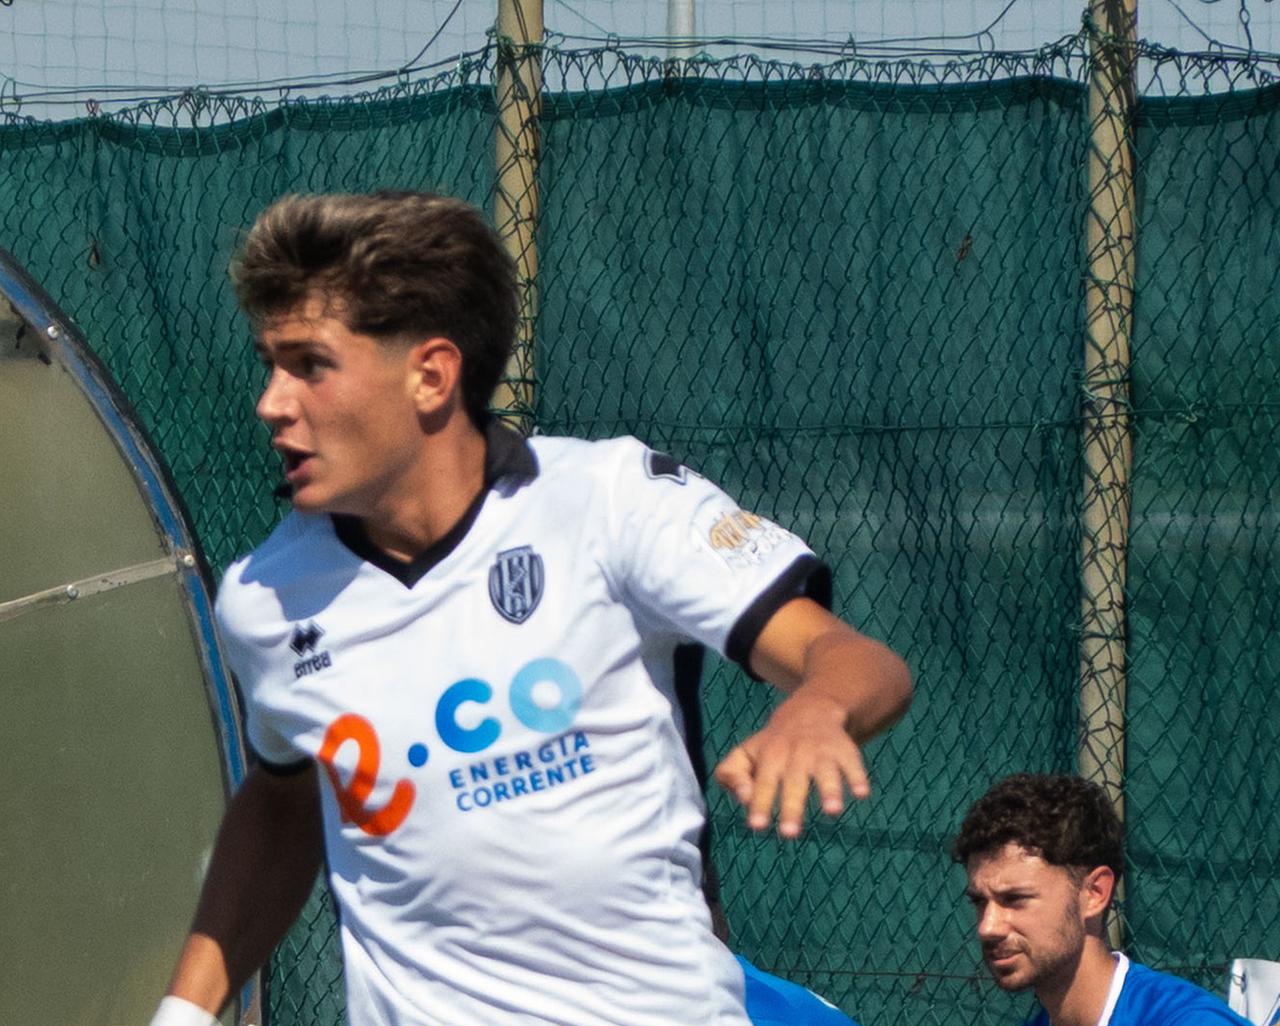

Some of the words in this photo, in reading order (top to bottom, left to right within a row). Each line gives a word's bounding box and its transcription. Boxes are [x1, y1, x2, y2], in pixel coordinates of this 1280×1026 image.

[293, 650, 332, 679] errea
[448, 731, 590, 789] ENERGIA
[456, 754, 597, 812] CORRENTE
